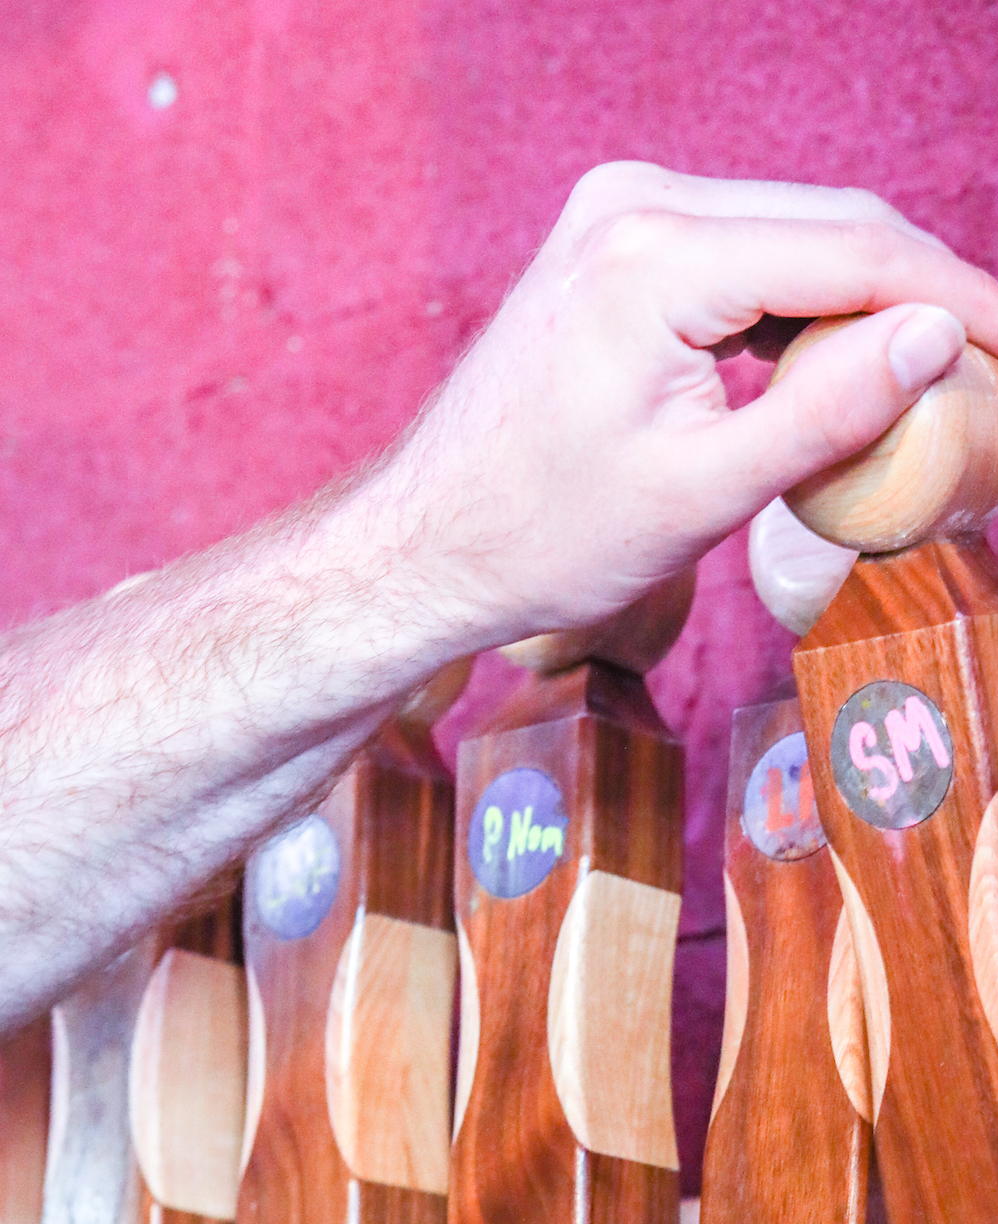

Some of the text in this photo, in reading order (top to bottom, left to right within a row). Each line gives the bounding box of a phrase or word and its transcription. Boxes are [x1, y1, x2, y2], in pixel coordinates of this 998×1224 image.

[849, 696, 950, 801] SM
[483, 805, 563, 862] P Nom
